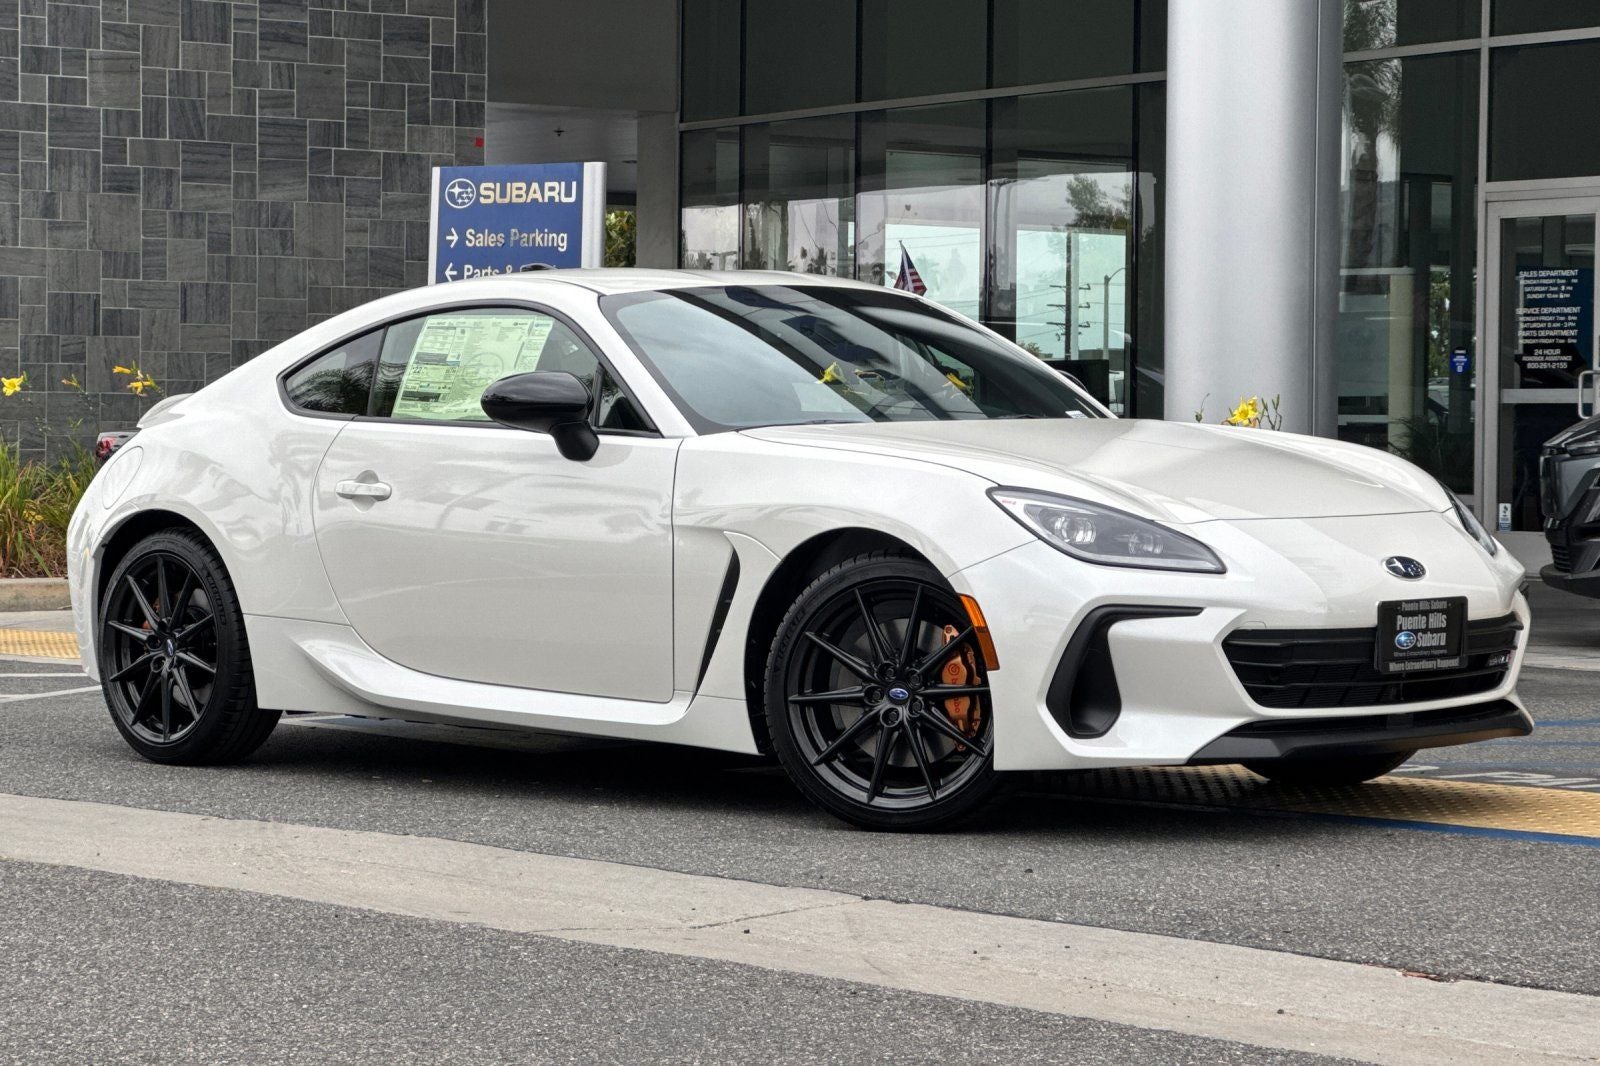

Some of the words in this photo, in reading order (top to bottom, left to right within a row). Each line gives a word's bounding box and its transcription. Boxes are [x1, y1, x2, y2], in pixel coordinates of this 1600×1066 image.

[480, 181, 576, 204] SUBARU
[466, 228, 504, 247] Sales
[510, 228, 568, 252] Parking
[1402, 601, 1418, 611] Puente
[1420, 601, 1430, 610] Hills
[1431, 600, 1447, 609] Subaru
[1397, 613, 1427, 630] Puente
[1428, 612, 1447, 628] Hills
[1417, 632, 1446, 647] Subaru
[1389, 662, 1404, 672] Where
[1405, 659, 1436, 670] Extraordinary
